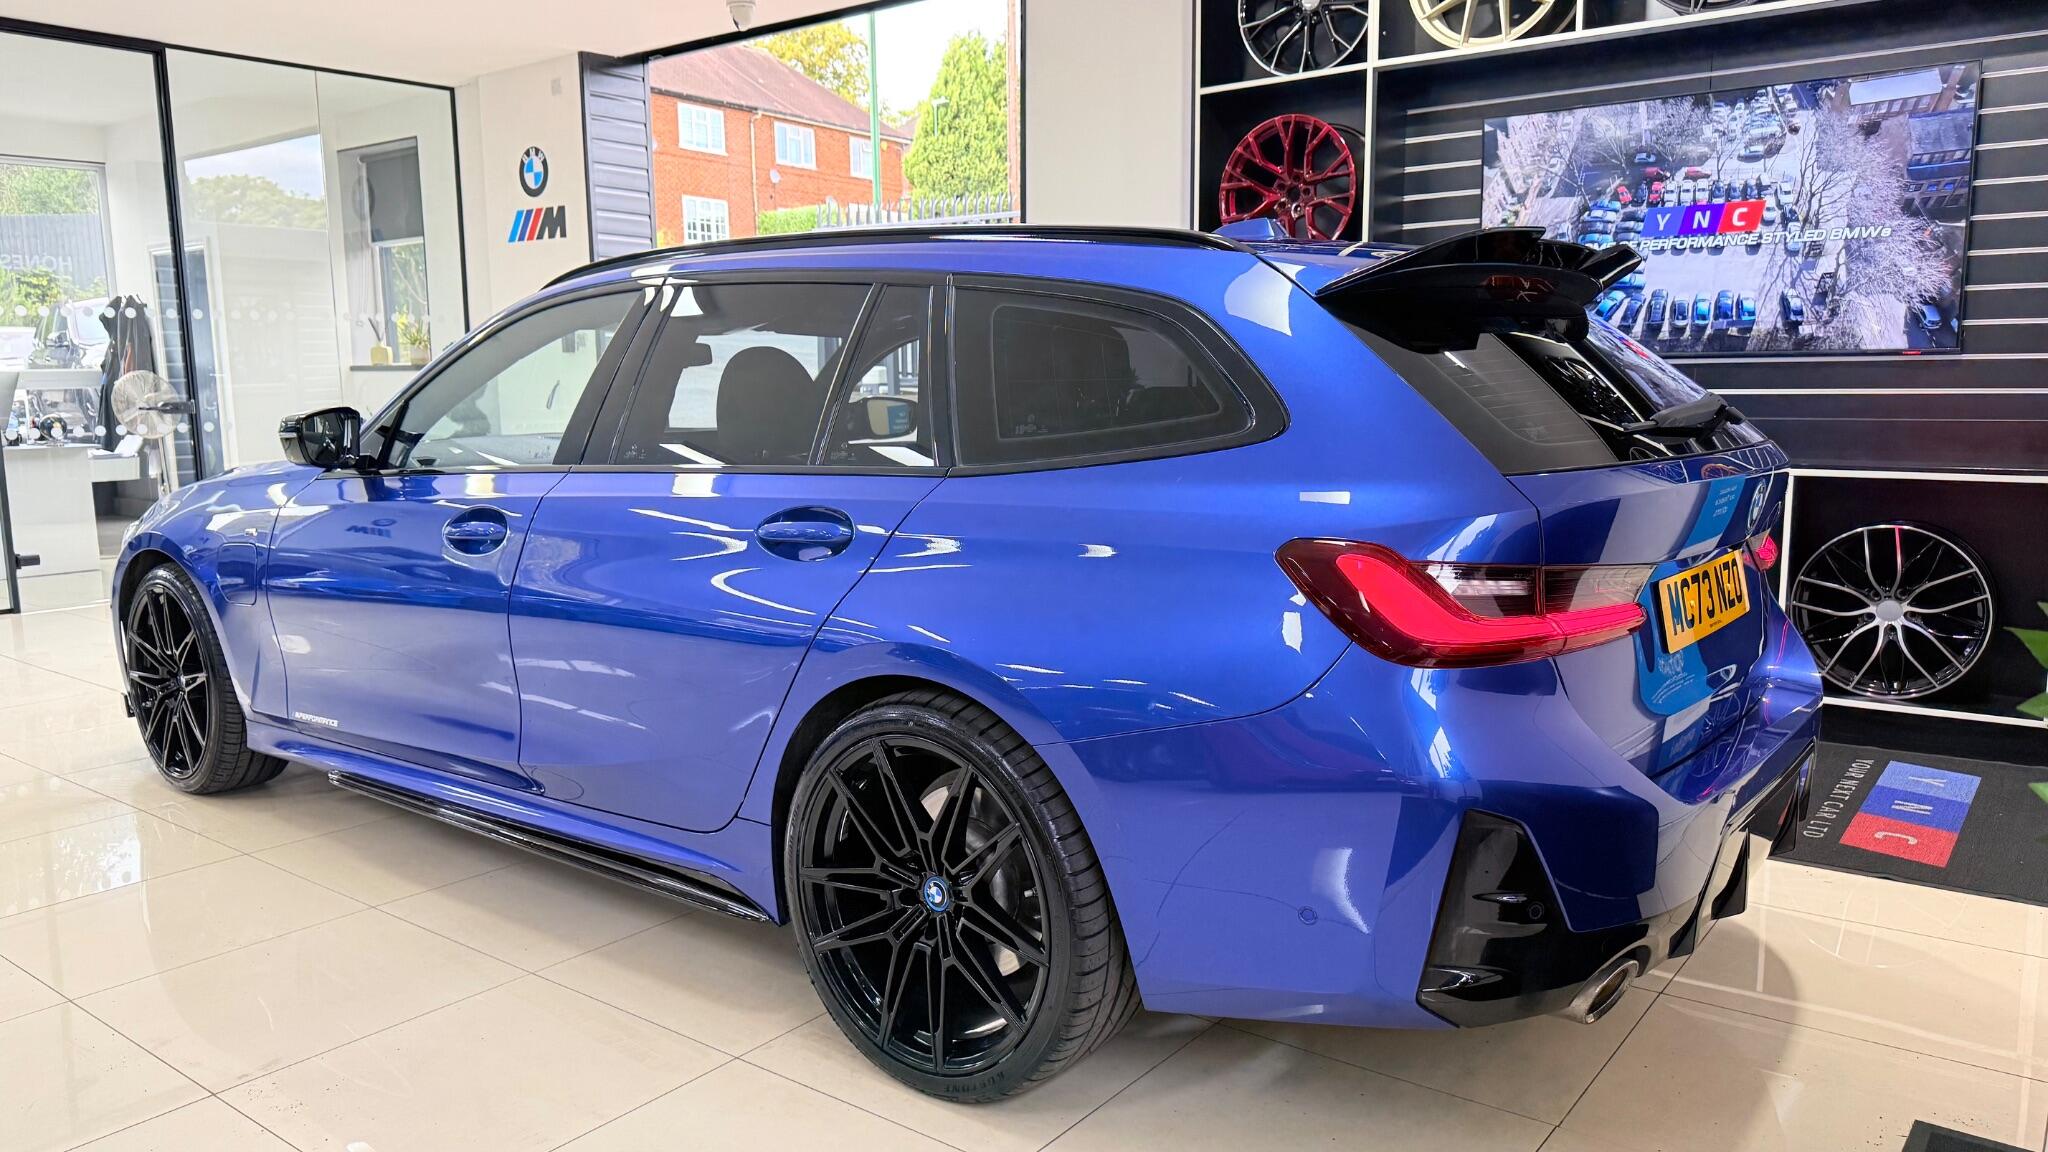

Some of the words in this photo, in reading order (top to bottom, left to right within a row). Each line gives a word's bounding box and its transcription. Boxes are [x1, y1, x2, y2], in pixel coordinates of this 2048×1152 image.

[1638, 233, 1759, 251] PERFORMANCE
[1761, 229, 1826, 244] STYLED
[1666, 569, 1716, 636] MC73
[1844, 759, 1875, 778] YOUR
[1829, 778, 1860, 800] NEXT
[1815, 801, 1844, 819] CAR
[1803, 820, 1832, 838] LTD
